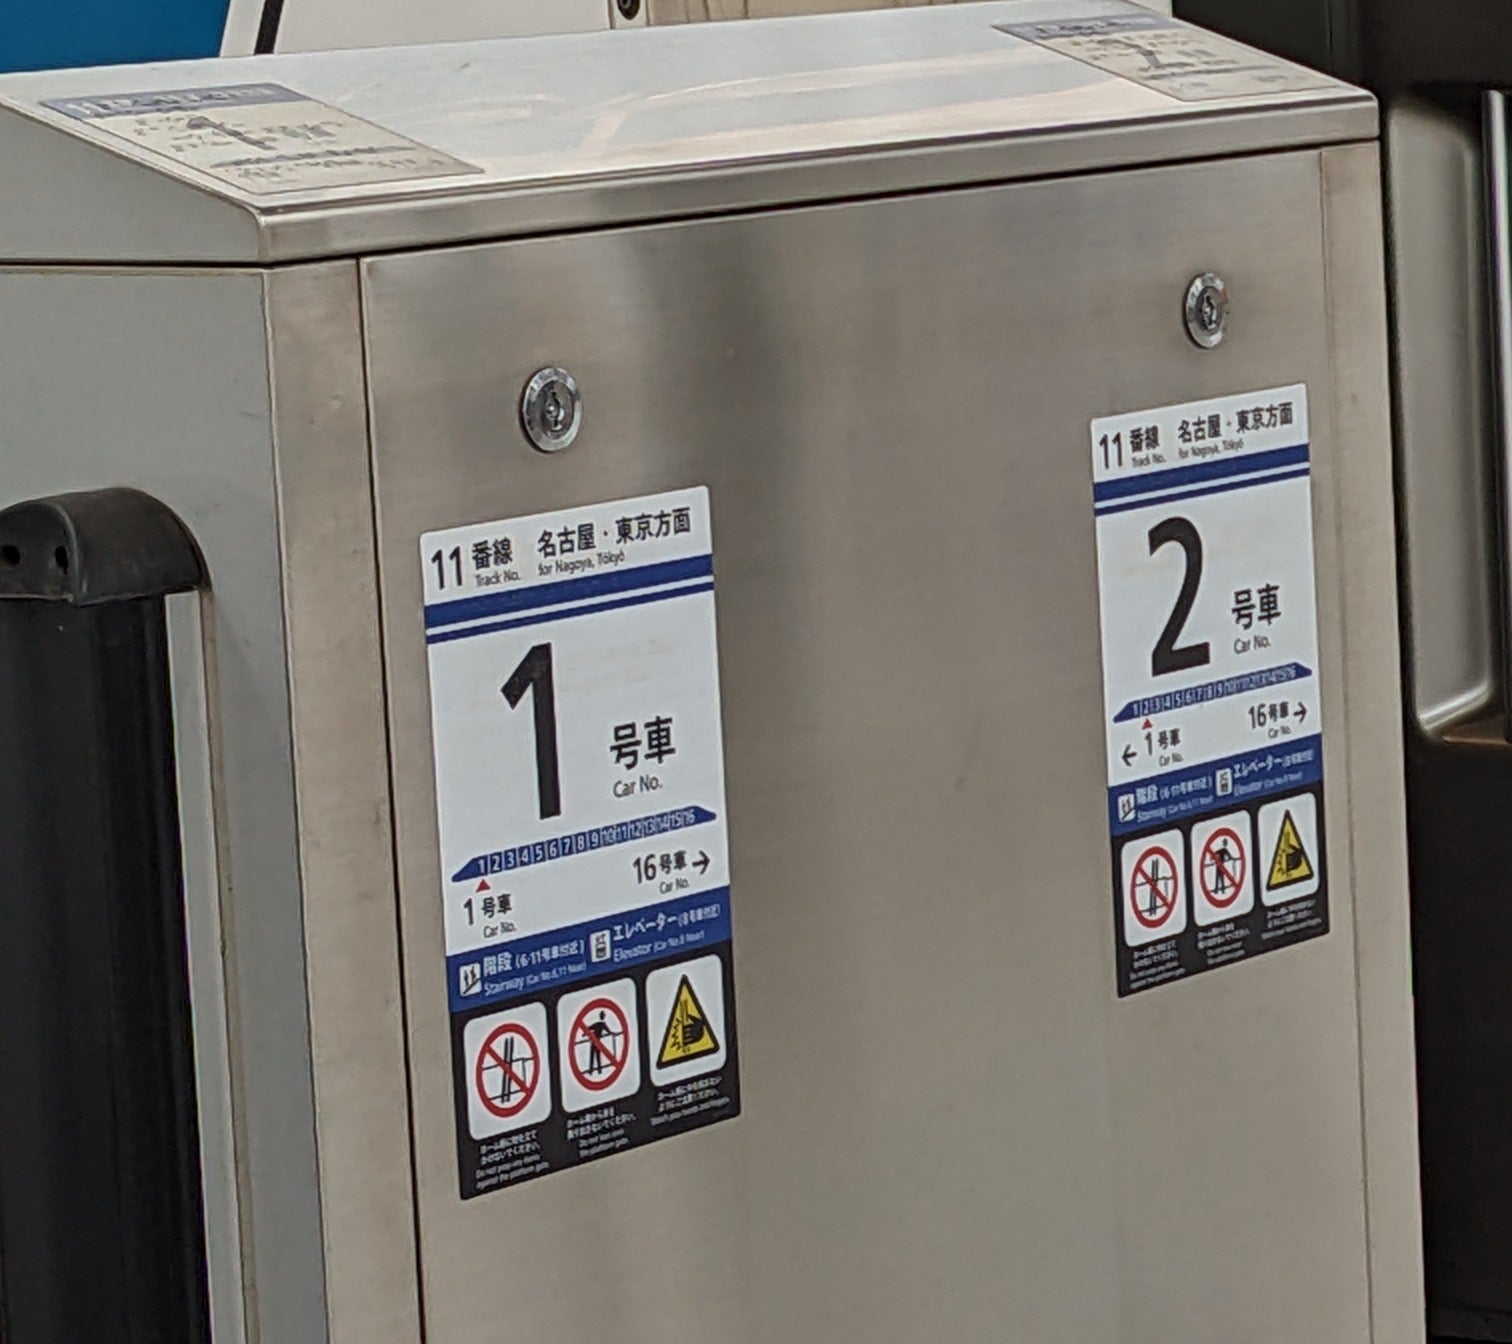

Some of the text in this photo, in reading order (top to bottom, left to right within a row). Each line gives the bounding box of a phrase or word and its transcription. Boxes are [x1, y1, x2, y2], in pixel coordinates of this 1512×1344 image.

[537, 507, 692, 559] 名古屋・東京方面
[1148, 516, 1211, 677] 2
[1232, 583, 1281, 630] 号車
[1234, 634, 1271, 655] Car No.
[501, 642, 561, 820] 1
[610, 715, 676, 770] 号車
[613, 775, 663, 799] Car No.
[464, 897, 474, 925] 1
